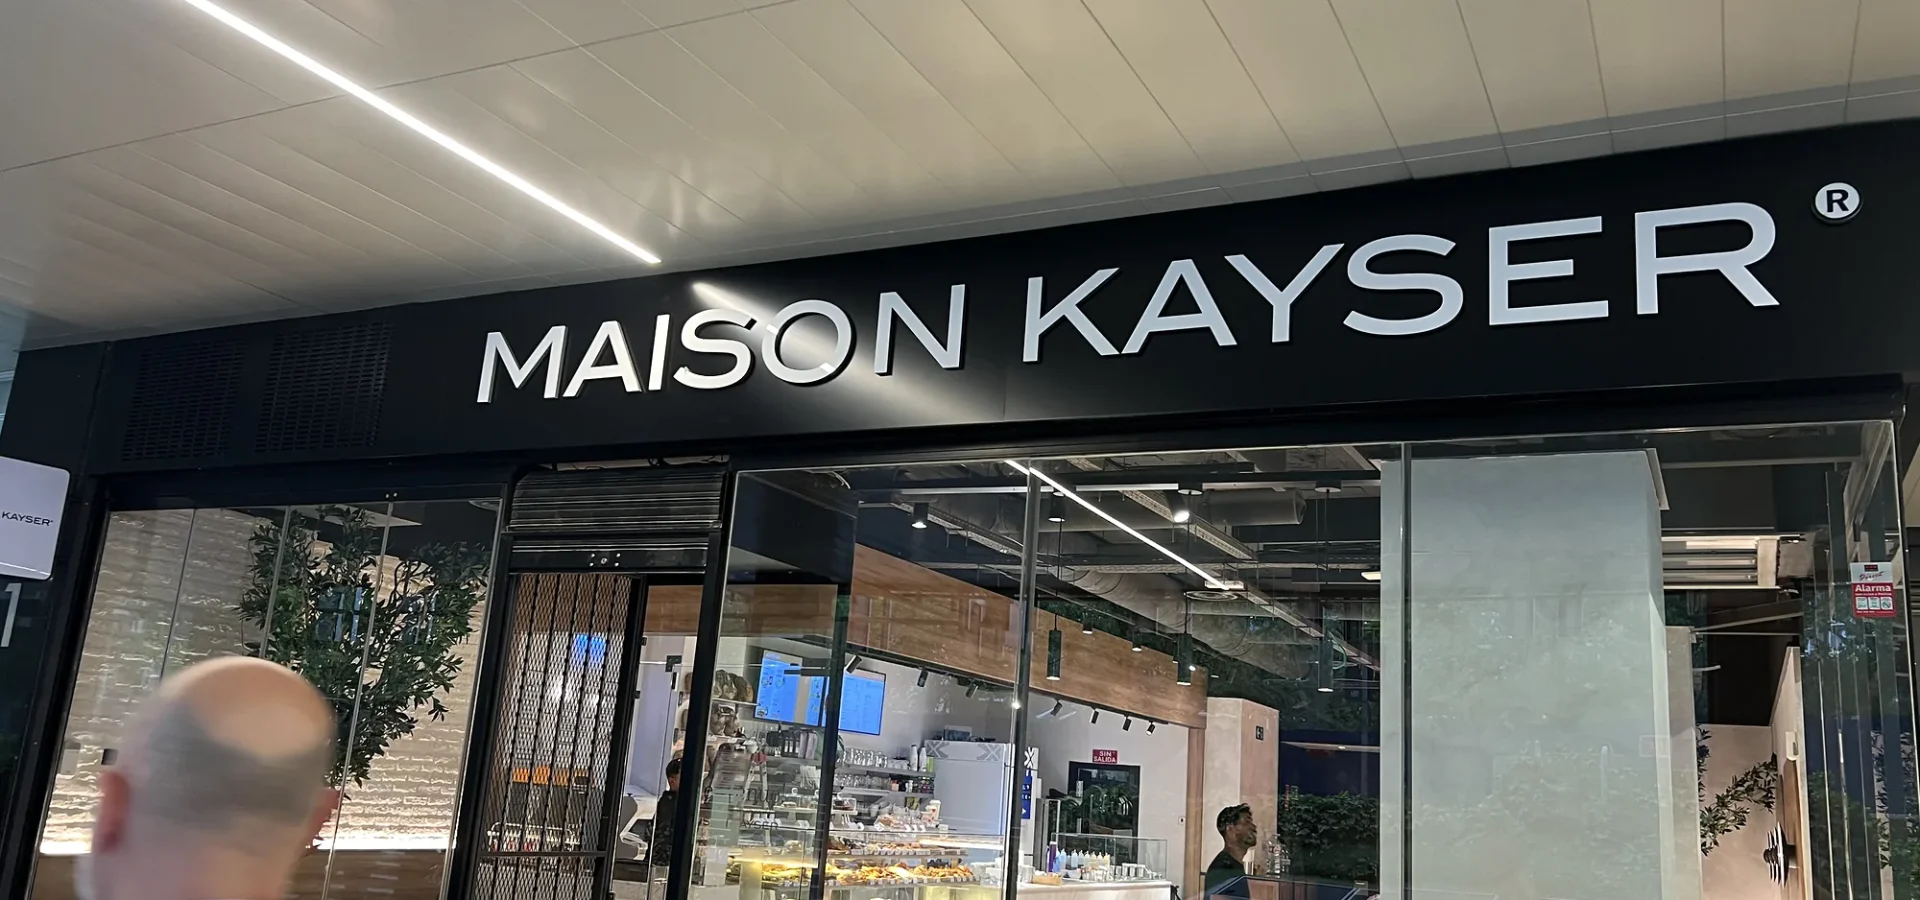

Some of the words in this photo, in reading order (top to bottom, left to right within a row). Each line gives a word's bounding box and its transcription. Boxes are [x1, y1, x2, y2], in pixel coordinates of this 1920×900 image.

[476, 284, 967, 403] MAISON
[1022, 202, 1780, 363] KAYSER
[1855, 584, 1892, 592] Alarma
